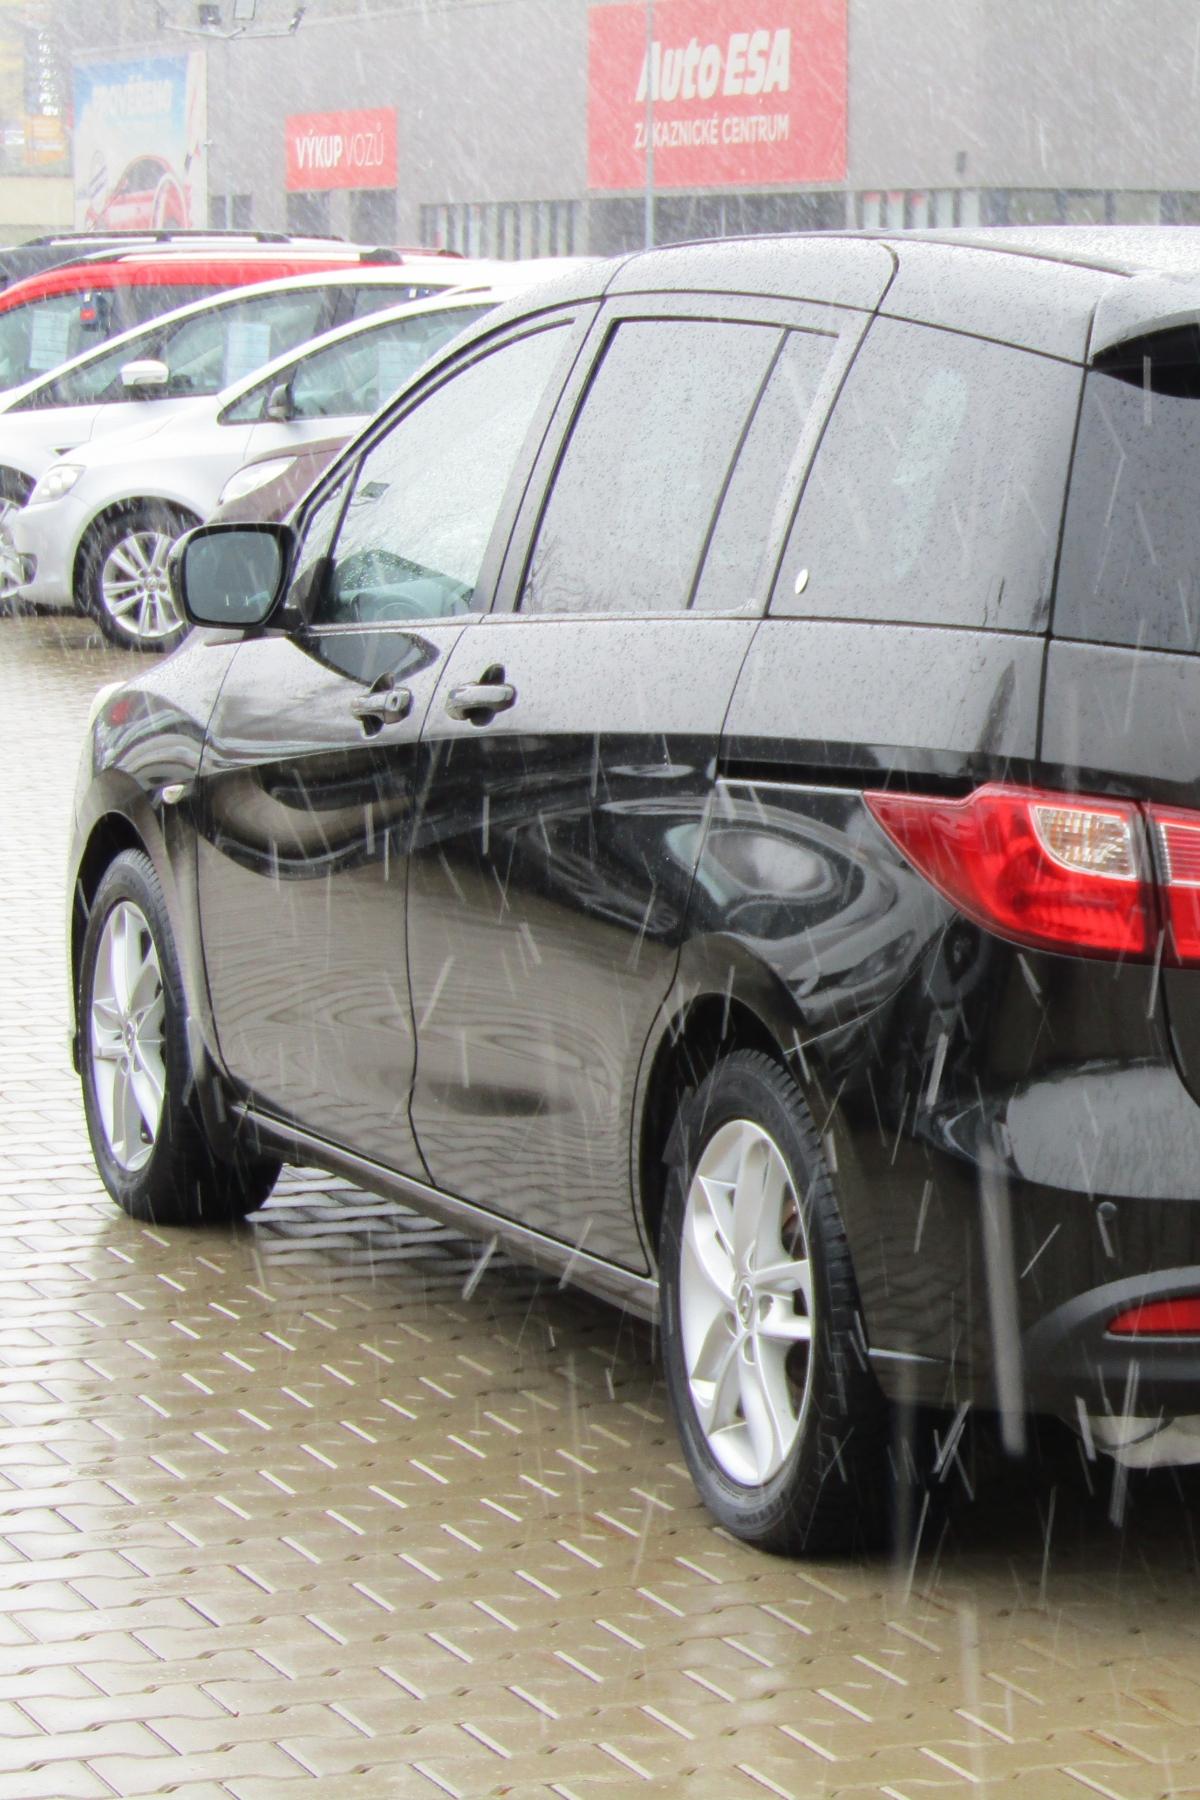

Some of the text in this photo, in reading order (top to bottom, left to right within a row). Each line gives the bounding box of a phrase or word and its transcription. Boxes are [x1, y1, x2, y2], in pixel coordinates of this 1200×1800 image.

[635, 28, 791, 102] Auto ESA
[295, 121, 384, 169] VÝKUP VOZŮ
[722, 113, 790, 145] CENTRUM
